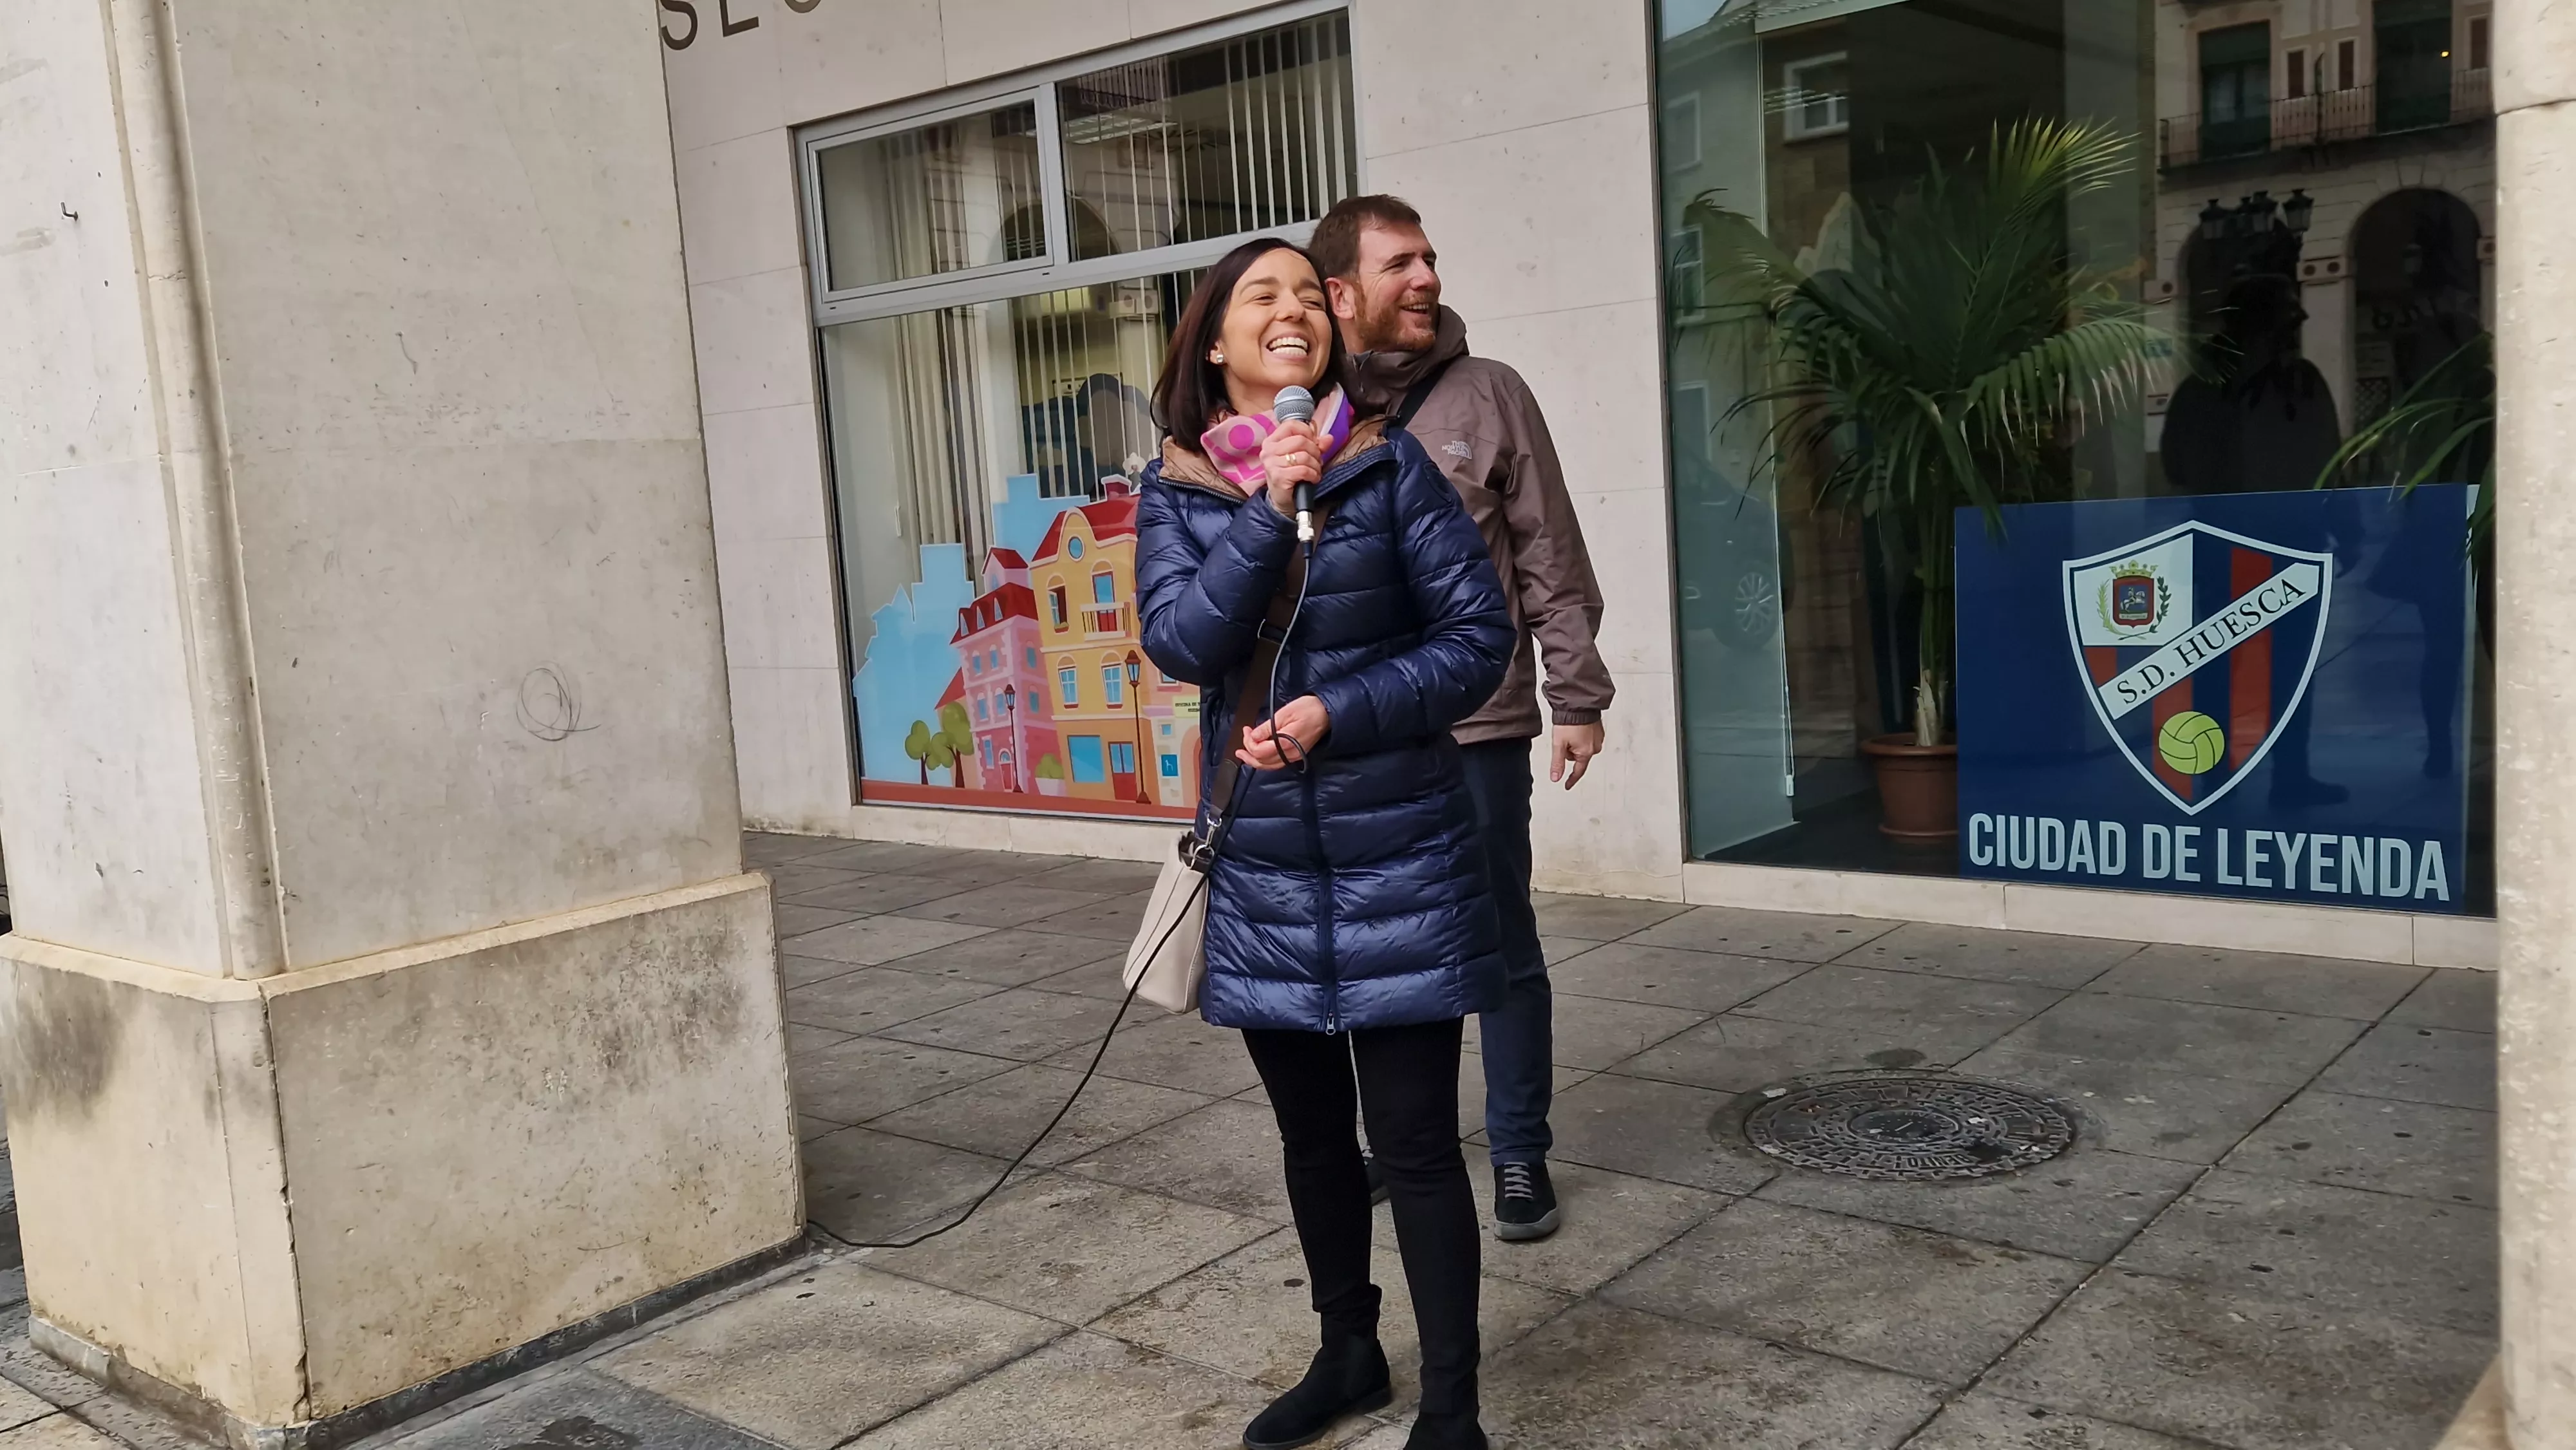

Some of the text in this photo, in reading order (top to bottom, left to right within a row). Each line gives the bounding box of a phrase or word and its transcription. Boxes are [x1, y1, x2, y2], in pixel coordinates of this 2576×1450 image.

[2117, 578, 2307, 705] S.D. HUESCA
[1968, 812, 2450, 901] CIUDAD DE LEYENDA
